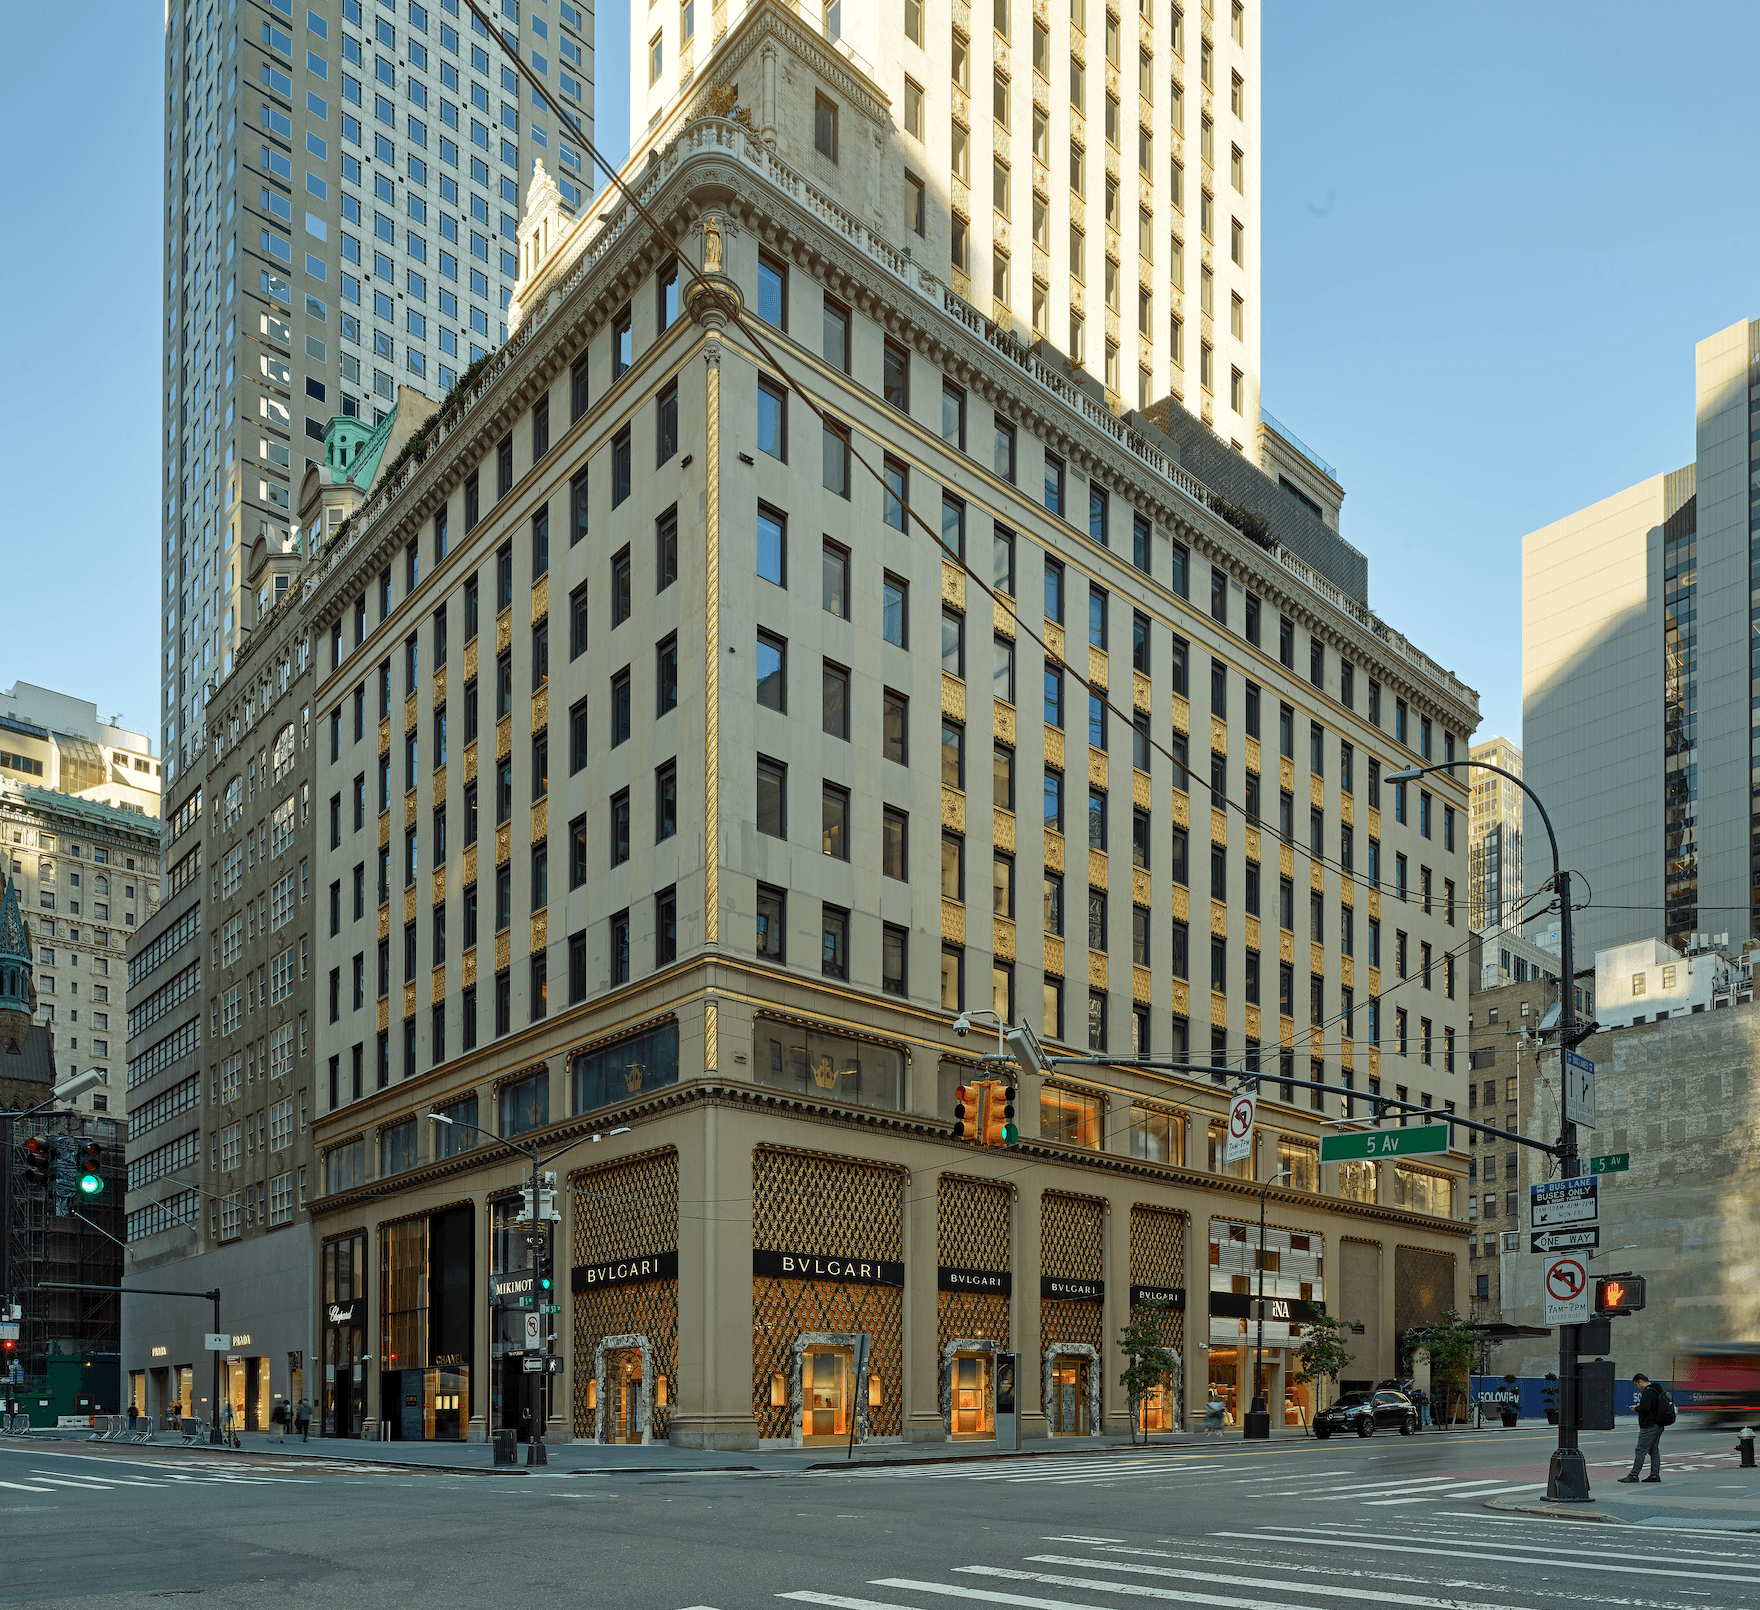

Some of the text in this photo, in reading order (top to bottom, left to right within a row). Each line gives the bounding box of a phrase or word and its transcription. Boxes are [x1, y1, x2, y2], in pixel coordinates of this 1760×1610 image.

[1367, 1134, 1399, 1154] 5 Av
[1598, 1156, 1622, 1172] 5 Av
[1549, 1177, 1591, 1192] BUS LANE
[1536, 1186, 1591, 1202] BUSES ONLY
[1535, 1200, 1594, 1214] 7AM-10AM 4PM-7PM
[1540, 1233, 1591, 1247] ONE WAY
[587, 1258, 658, 1283] BVLGARI
[782, 1256, 881, 1279] BVLGARI
[495, 1278, 534, 1295] MIKIMOT
[950, 1273, 1001, 1286] BVLGARI
[1051, 1282, 1095, 1295] BVLGARI
[1139, 1290, 1178, 1302] BVLGARI
[328, 1304, 354, 1324] Chopard
[1547, 1303, 1586, 1314] 7AM-7PM
[232, 1334, 251, 1347] PRADA
[151, 1345, 167, 1357] PRADA
[435, 1353, 464, 1365] CHANEL
